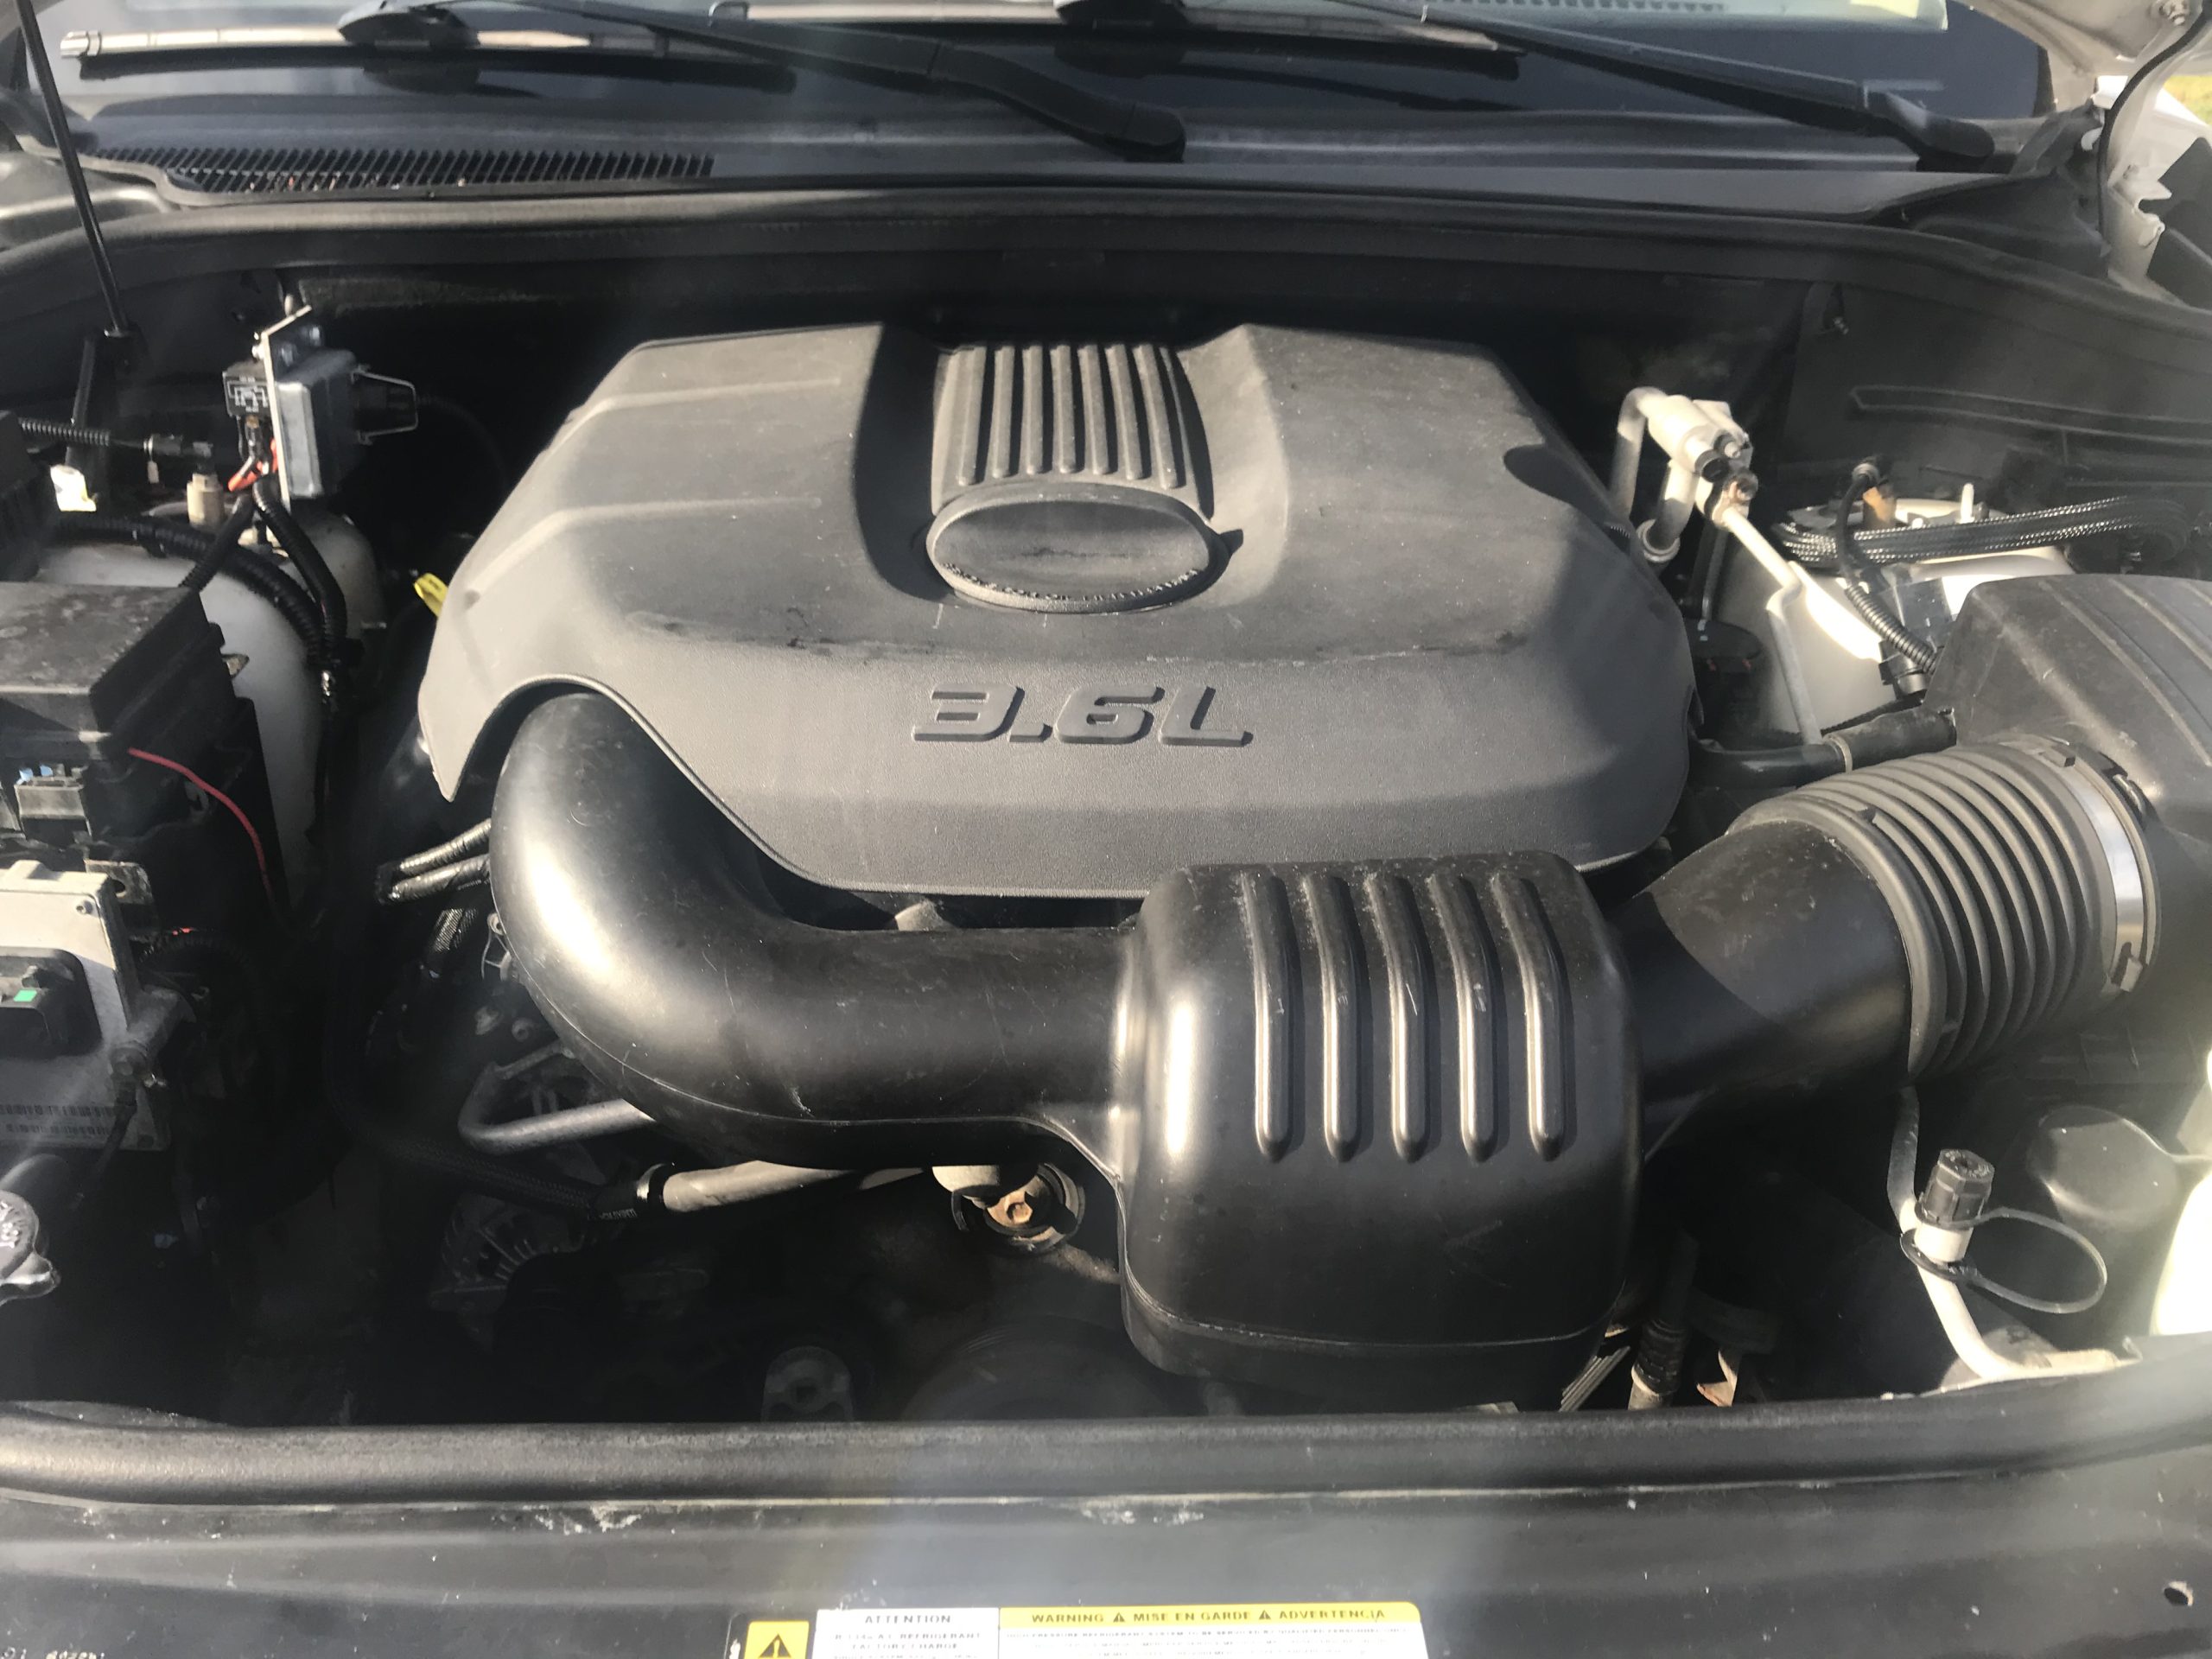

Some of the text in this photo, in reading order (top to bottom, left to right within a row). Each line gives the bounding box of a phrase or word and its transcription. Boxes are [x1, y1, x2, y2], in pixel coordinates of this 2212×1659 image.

[912, 682, 1254, 747] 3.6L
[864, 1614, 951, 1624] ATTENTION
[1031, 1609, 1386, 1623] WARNING MISE EN GARDE ADVERTENCIA
